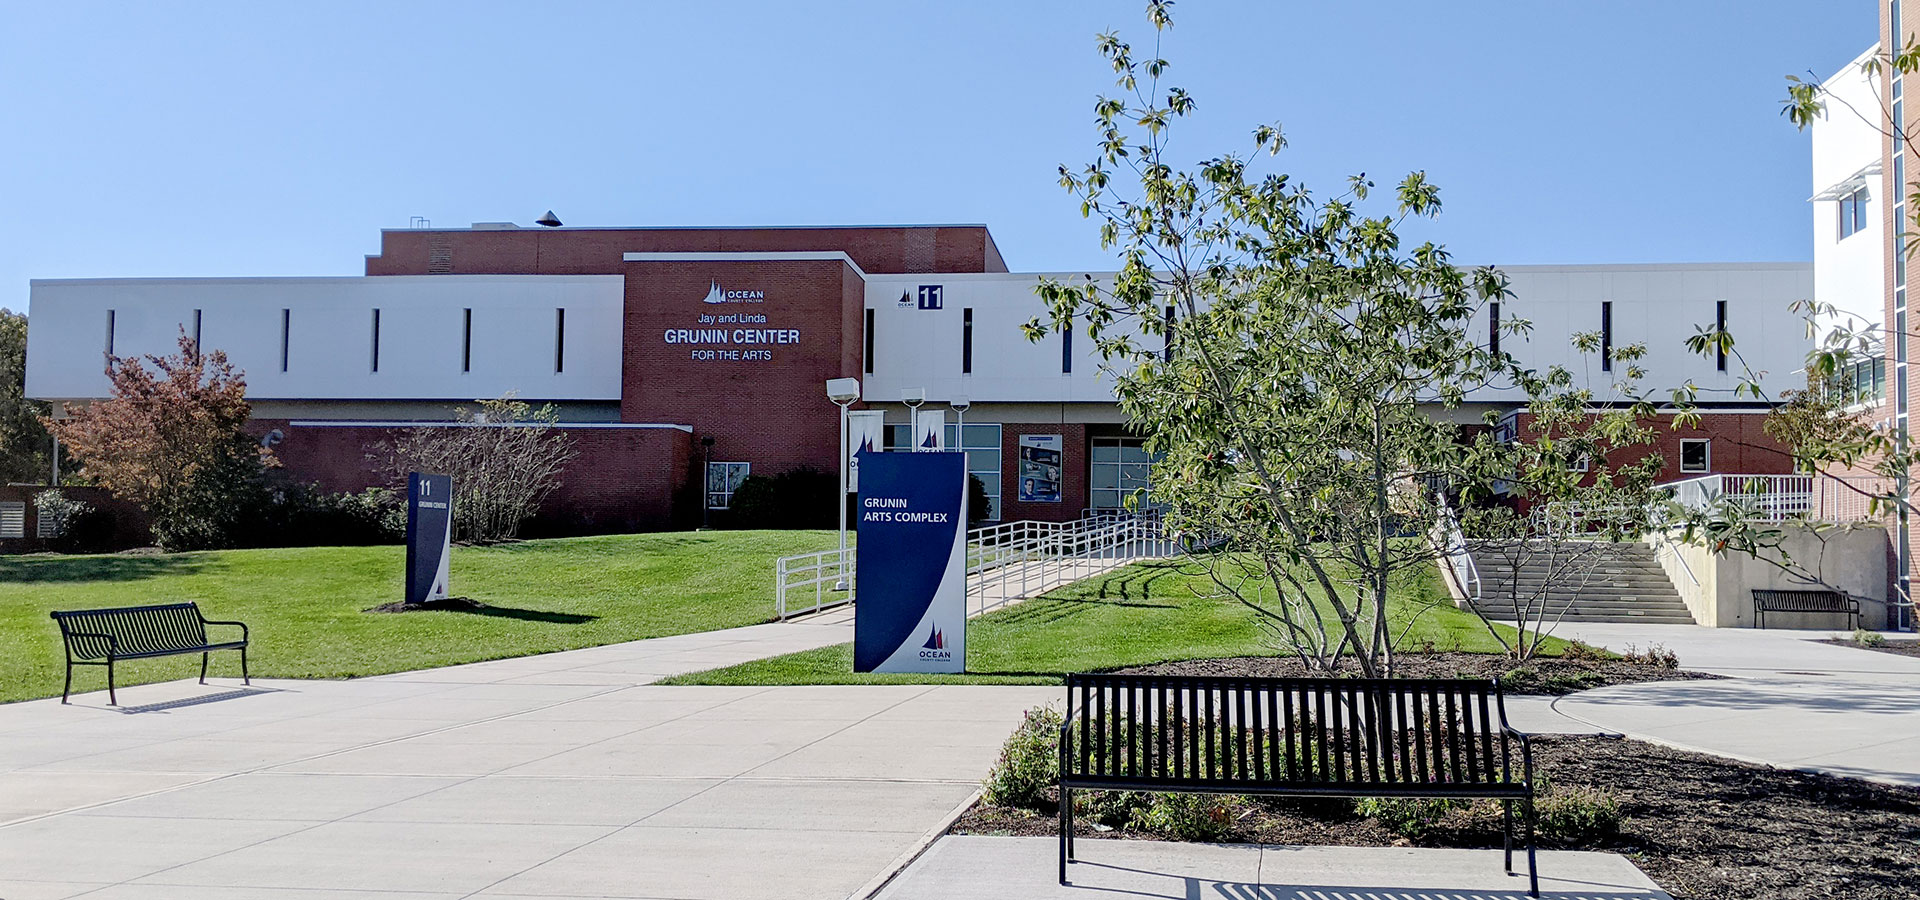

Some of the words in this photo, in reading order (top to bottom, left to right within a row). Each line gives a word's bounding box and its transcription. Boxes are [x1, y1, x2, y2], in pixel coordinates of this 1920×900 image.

[727, 290, 764, 299] OCEAN
[920, 287, 941, 307] 11
[698, 313, 716, 326] Jay
[718, 313, 737, 323] and
[739, 313, 767, 323] Linda
[664, 329, 728, 344] GRUNIN
[732, 329, 800, 344] CENTER
[691, 350, 715, 360] FOR
[718, 350, 740, 360] THE
[742, 350, 772, 360] ARTS
[419, 479, 430, 496] 11
[863, 498, 907, 508] GRUNIN
[863, 511, 892, 522] ARTS
[894, 512, 948, 523] COMPLEX
[919, 651, 951, 659] OCEAN
